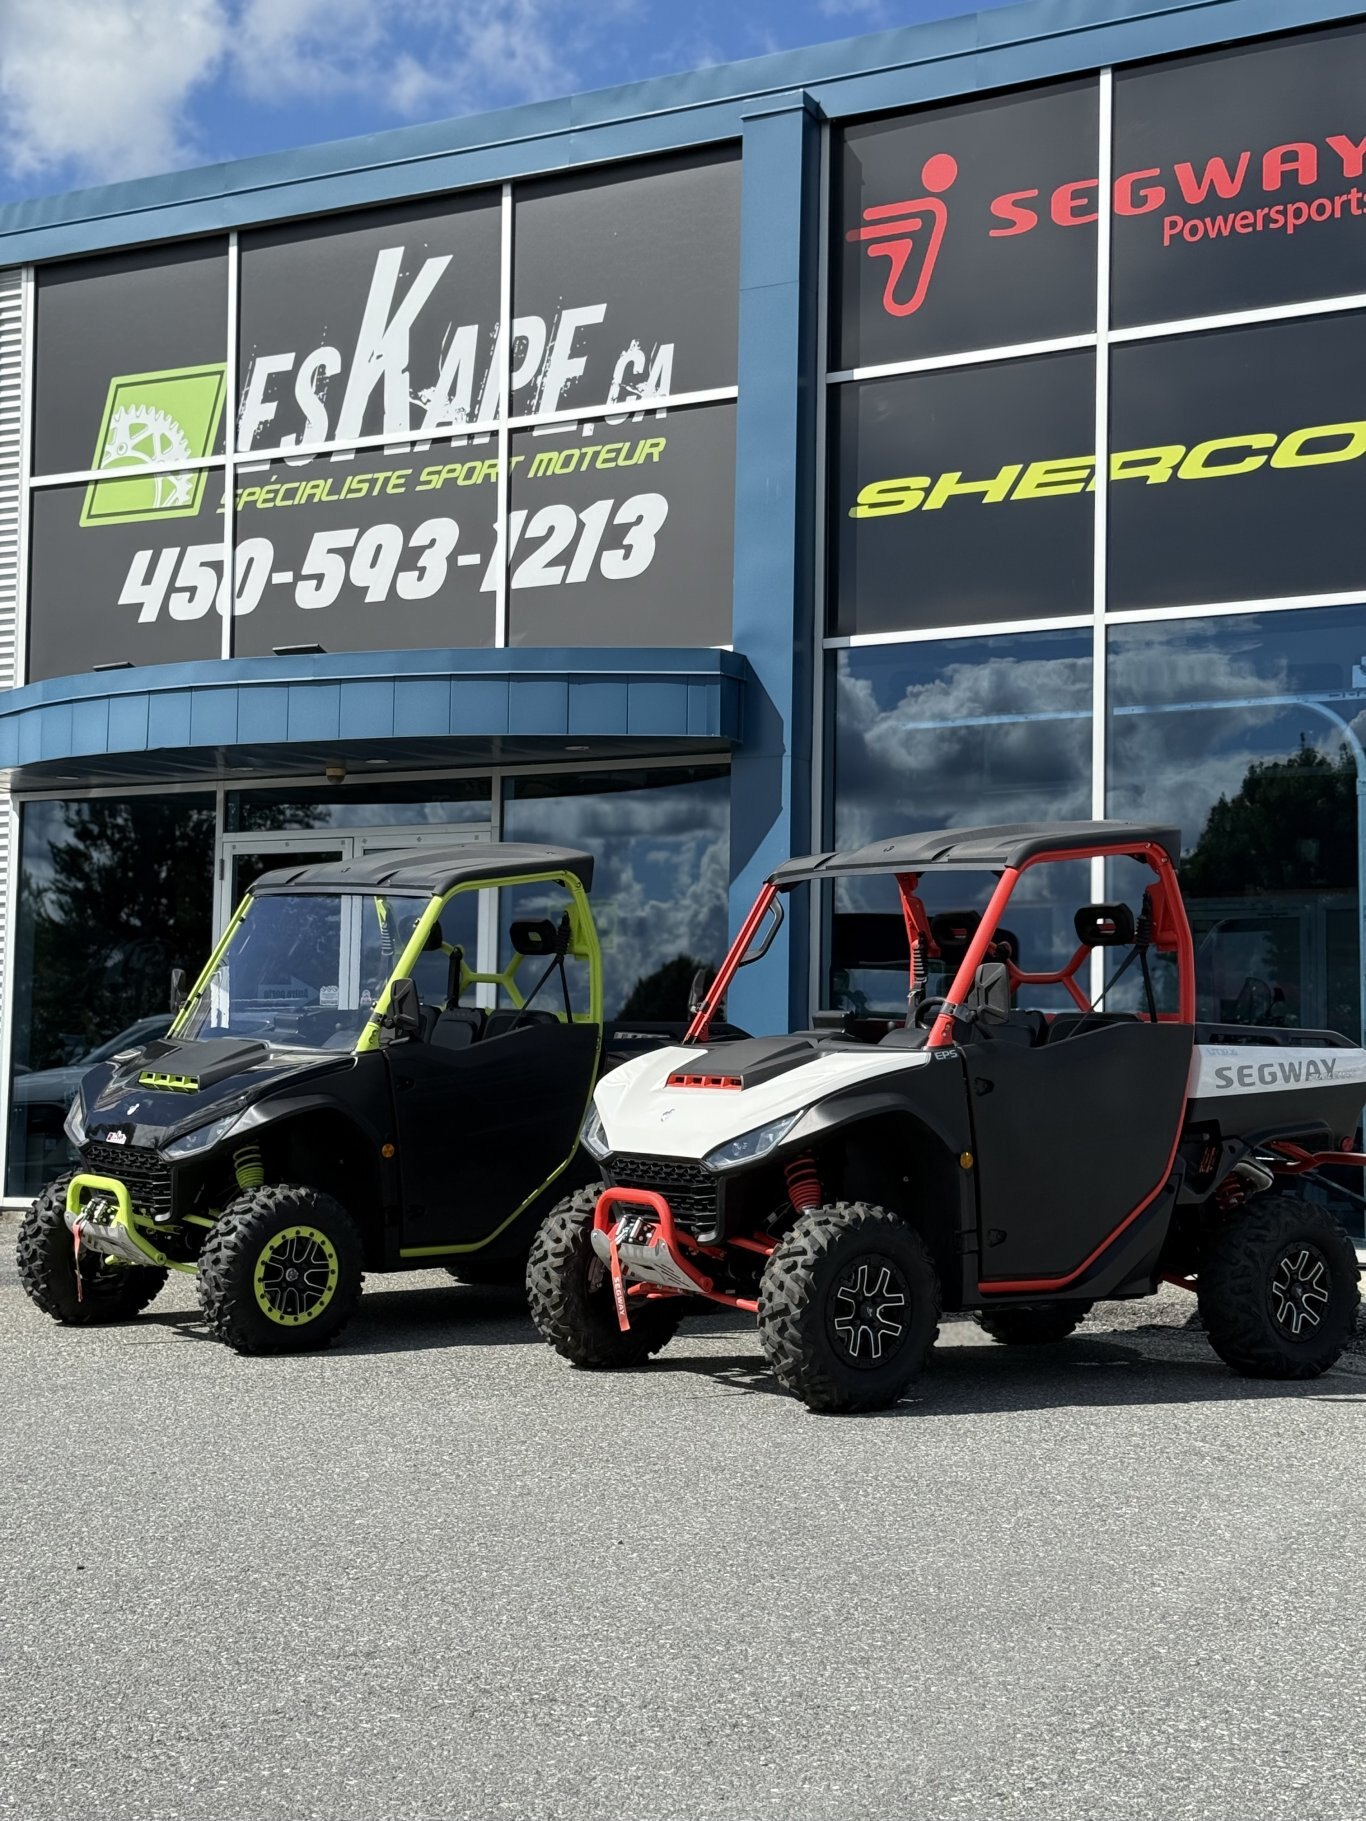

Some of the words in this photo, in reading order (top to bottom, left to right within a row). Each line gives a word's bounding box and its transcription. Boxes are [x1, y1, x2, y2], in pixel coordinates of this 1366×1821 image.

[989, 135, 1366, 237] SEGWAY
[1163, 187, 1366, 247] Powersport
[527, 437, 667, 479] MOTEUR
[848, 420, 1366, 519] SHERCO
[117, 492, 669, 624] 450-593-1213
[933, 1049, 959, 1061] EPS
[1214, 1057, 1337, 1090] SEGWAY
[613, 1277, 625, 1315] SEGWAY
